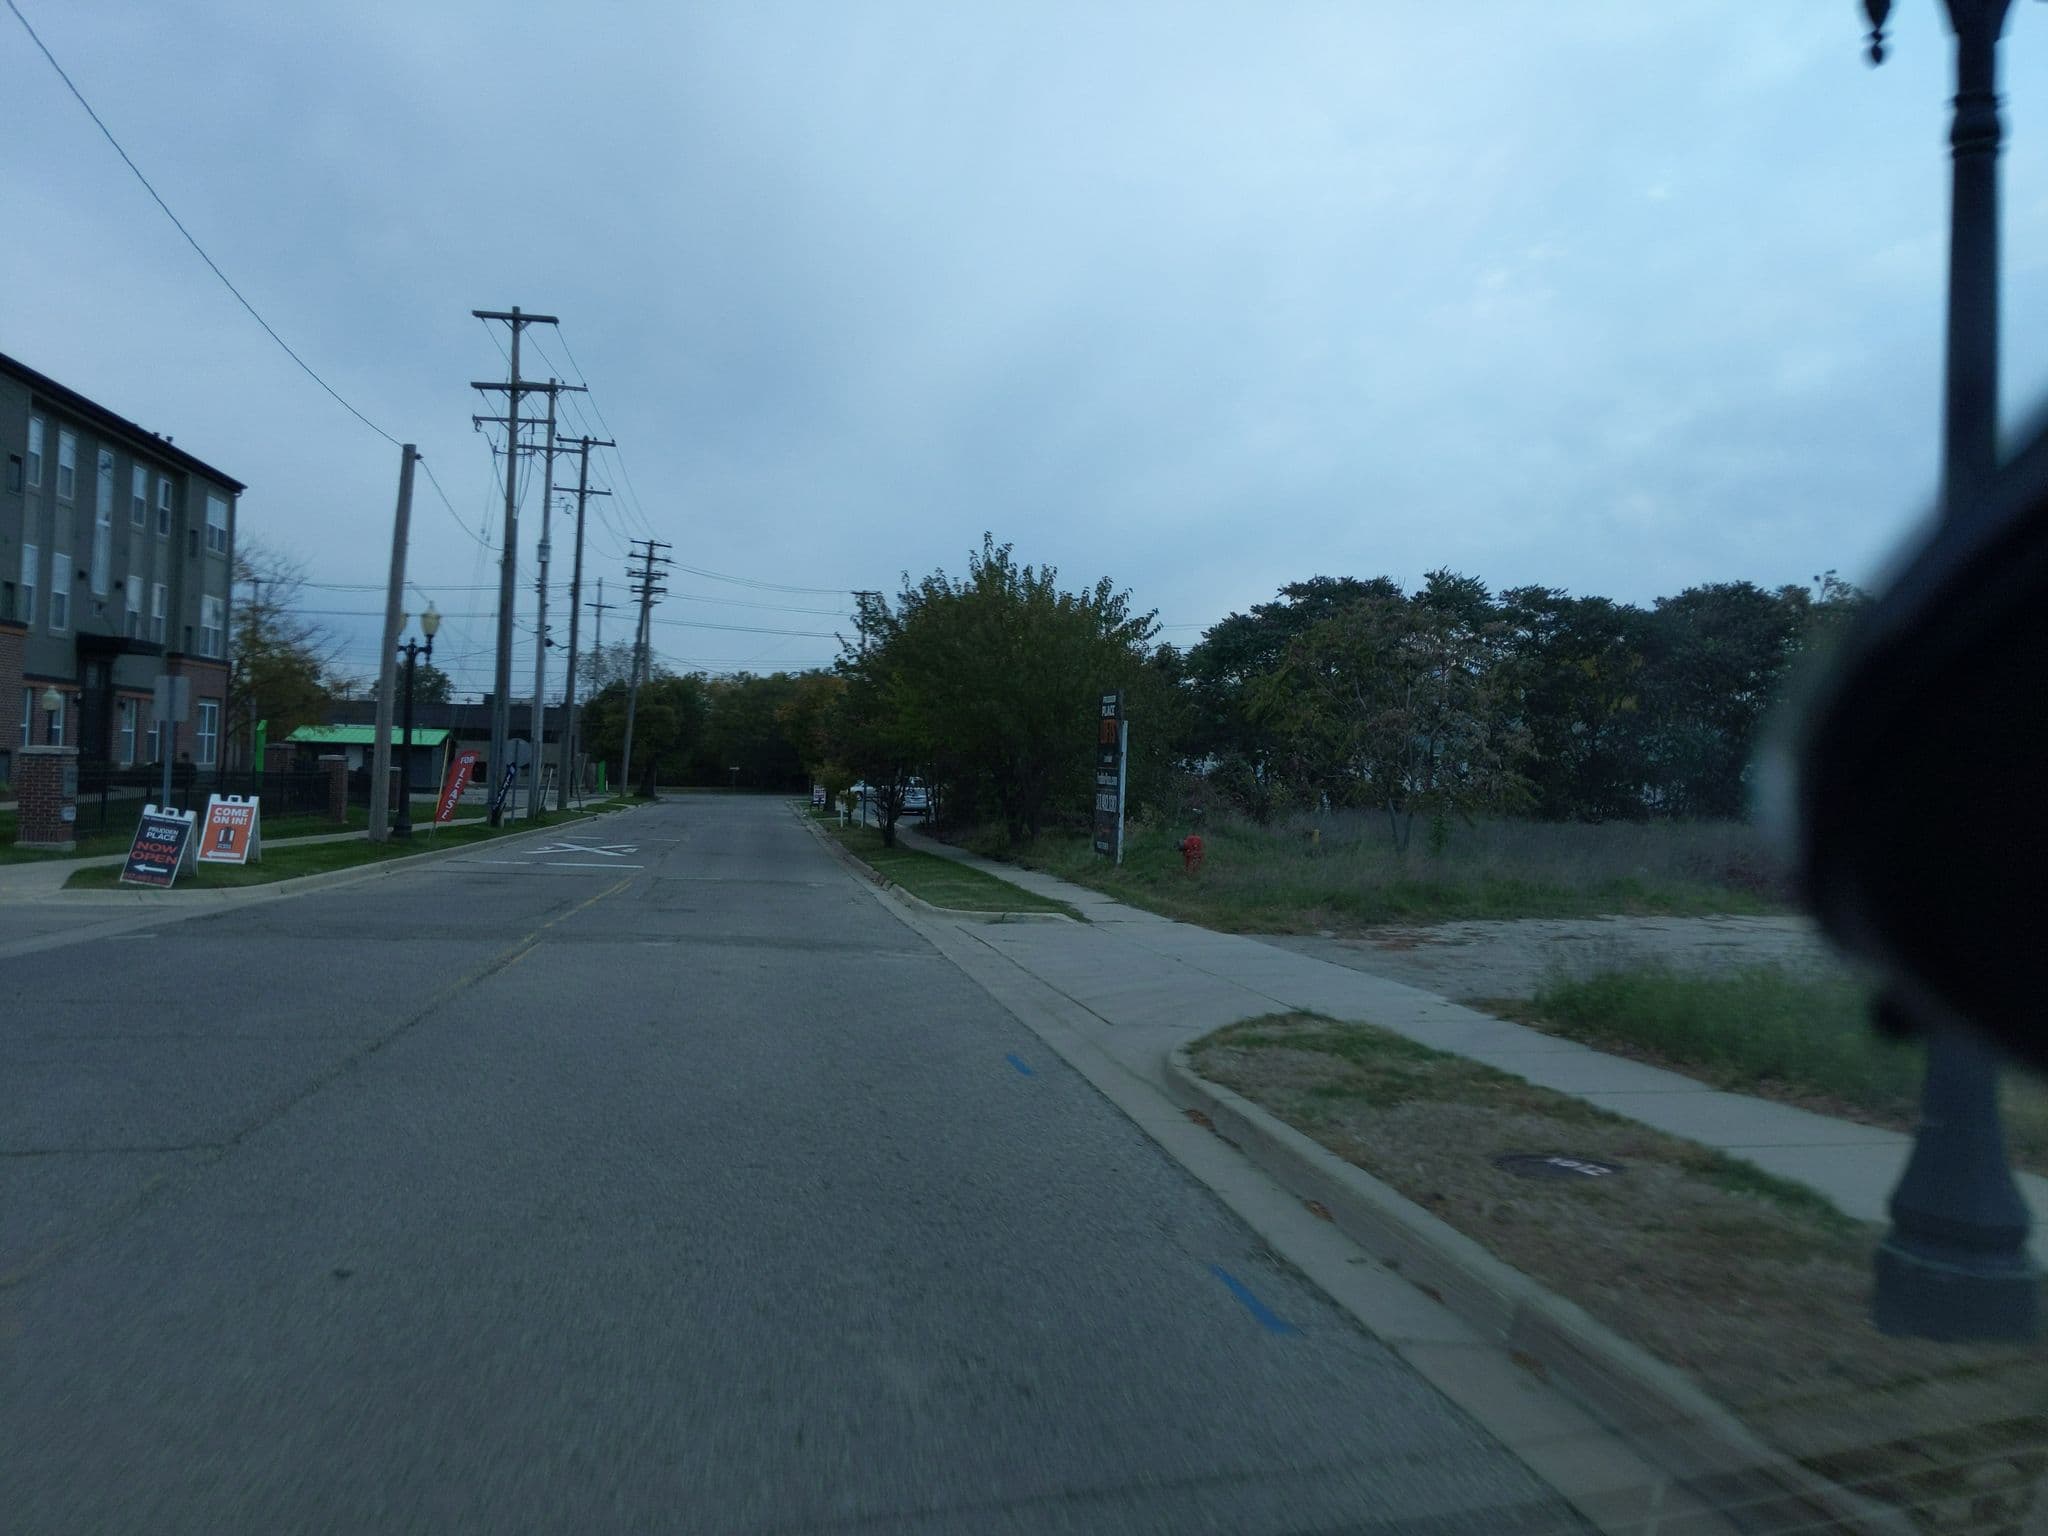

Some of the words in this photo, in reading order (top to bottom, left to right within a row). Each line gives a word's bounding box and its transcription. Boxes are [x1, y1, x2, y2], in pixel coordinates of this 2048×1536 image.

[461, 756, 474, 764] FOR
[441, 767, 465, 820] LEASE
[215, 807, 249, 817] COME
[213, 816, 229, 824] ON
[231, 816, 248, 826] IN!
[146, 832, 177, 841] PLACE
[137, 841, 177, 853] NOW
[131, 852, 177, 864] OPEN
